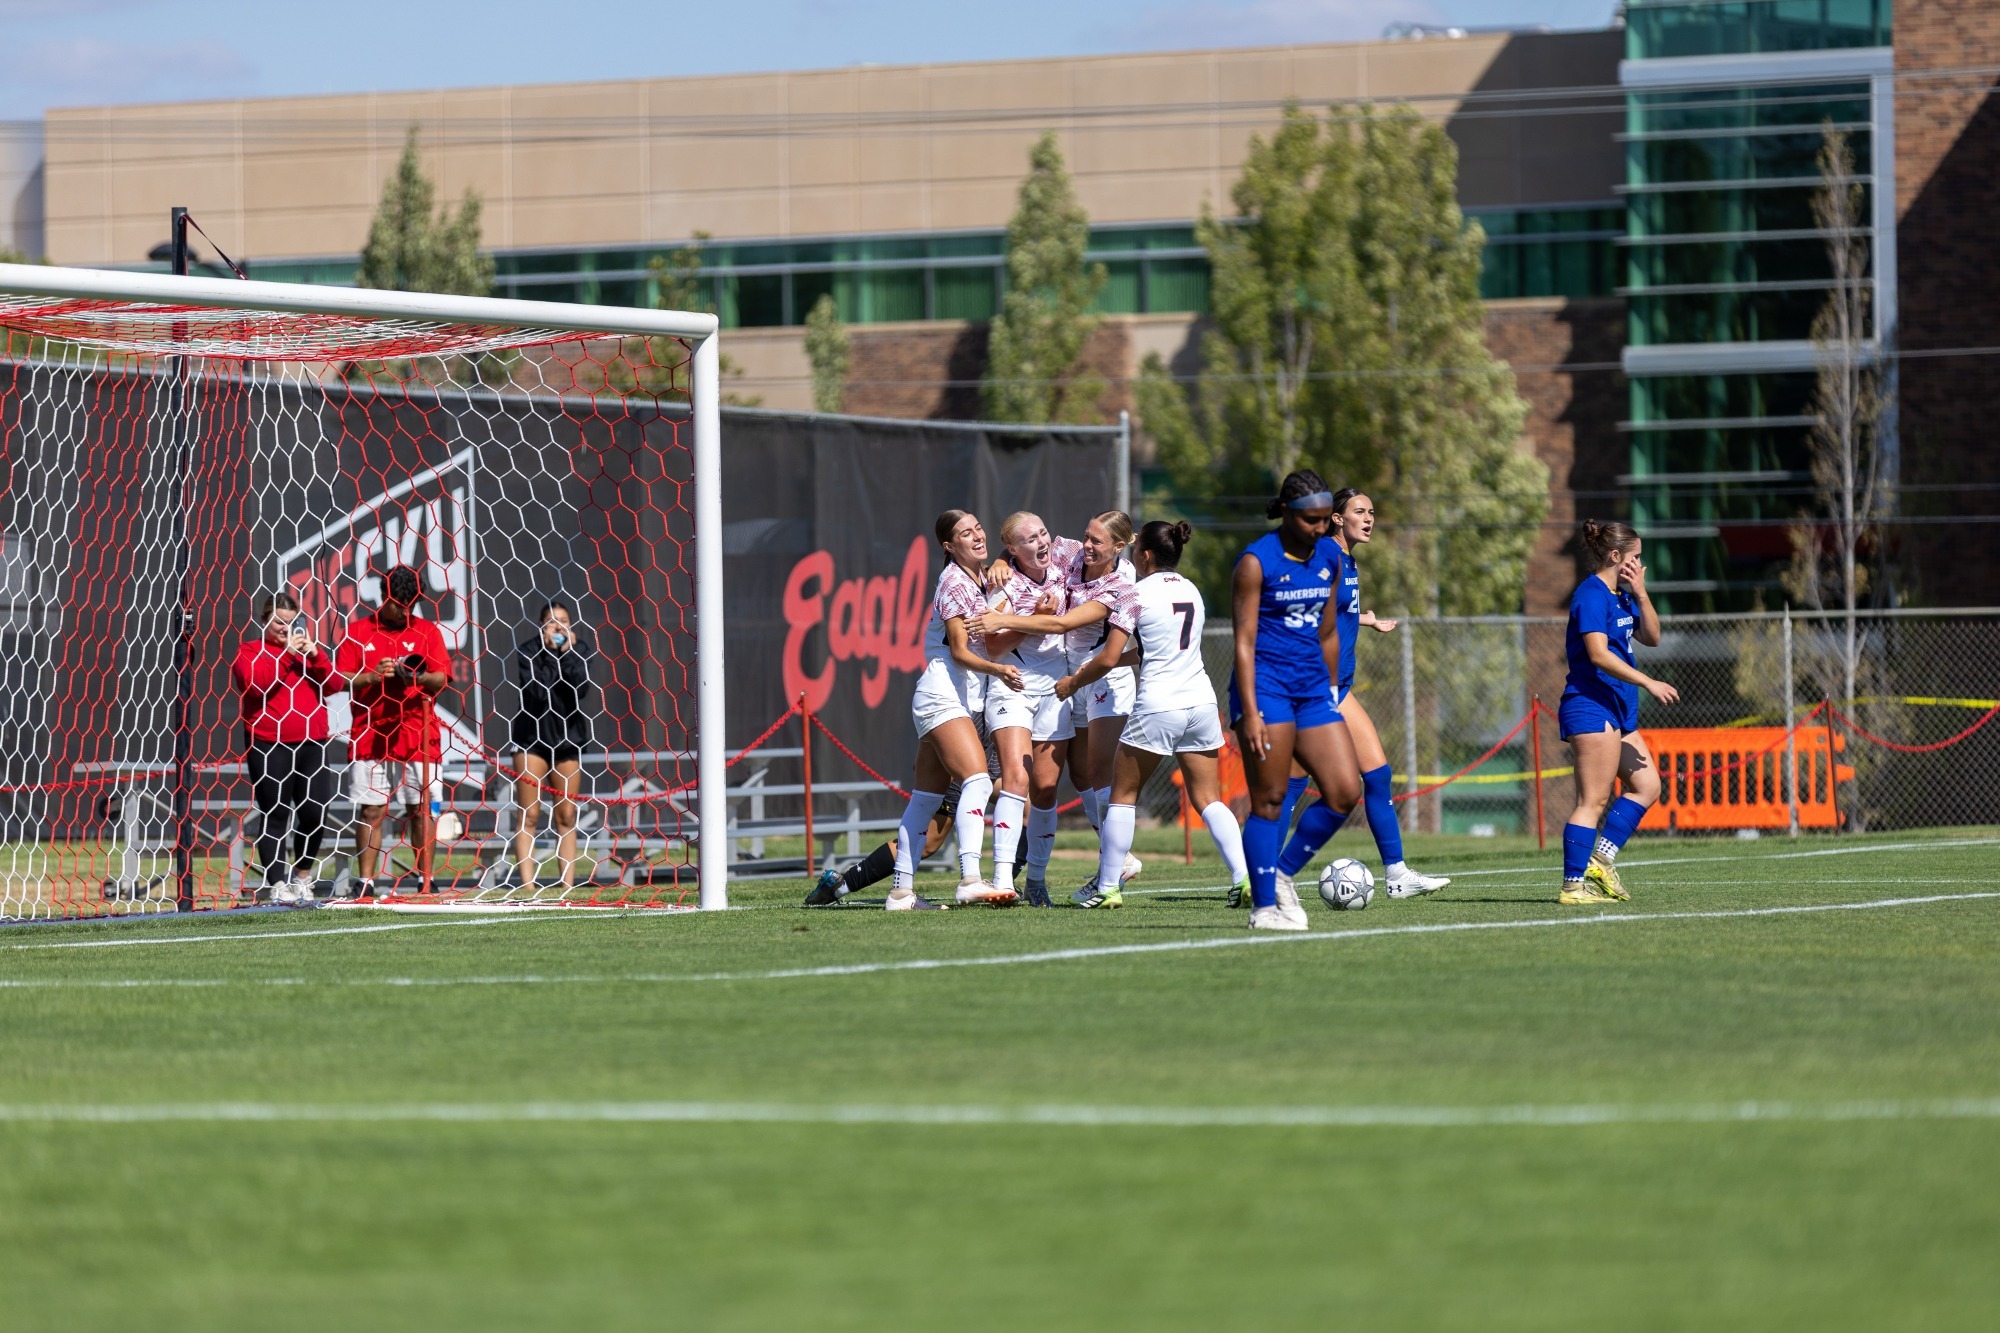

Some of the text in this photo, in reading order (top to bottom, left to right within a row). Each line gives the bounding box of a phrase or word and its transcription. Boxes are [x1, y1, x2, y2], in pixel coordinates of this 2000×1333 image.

[289, 486, 468, 650] BIG SKY
[1172, 602, 1195, 650] 7
[1284, 602, 1324, 628] 34
